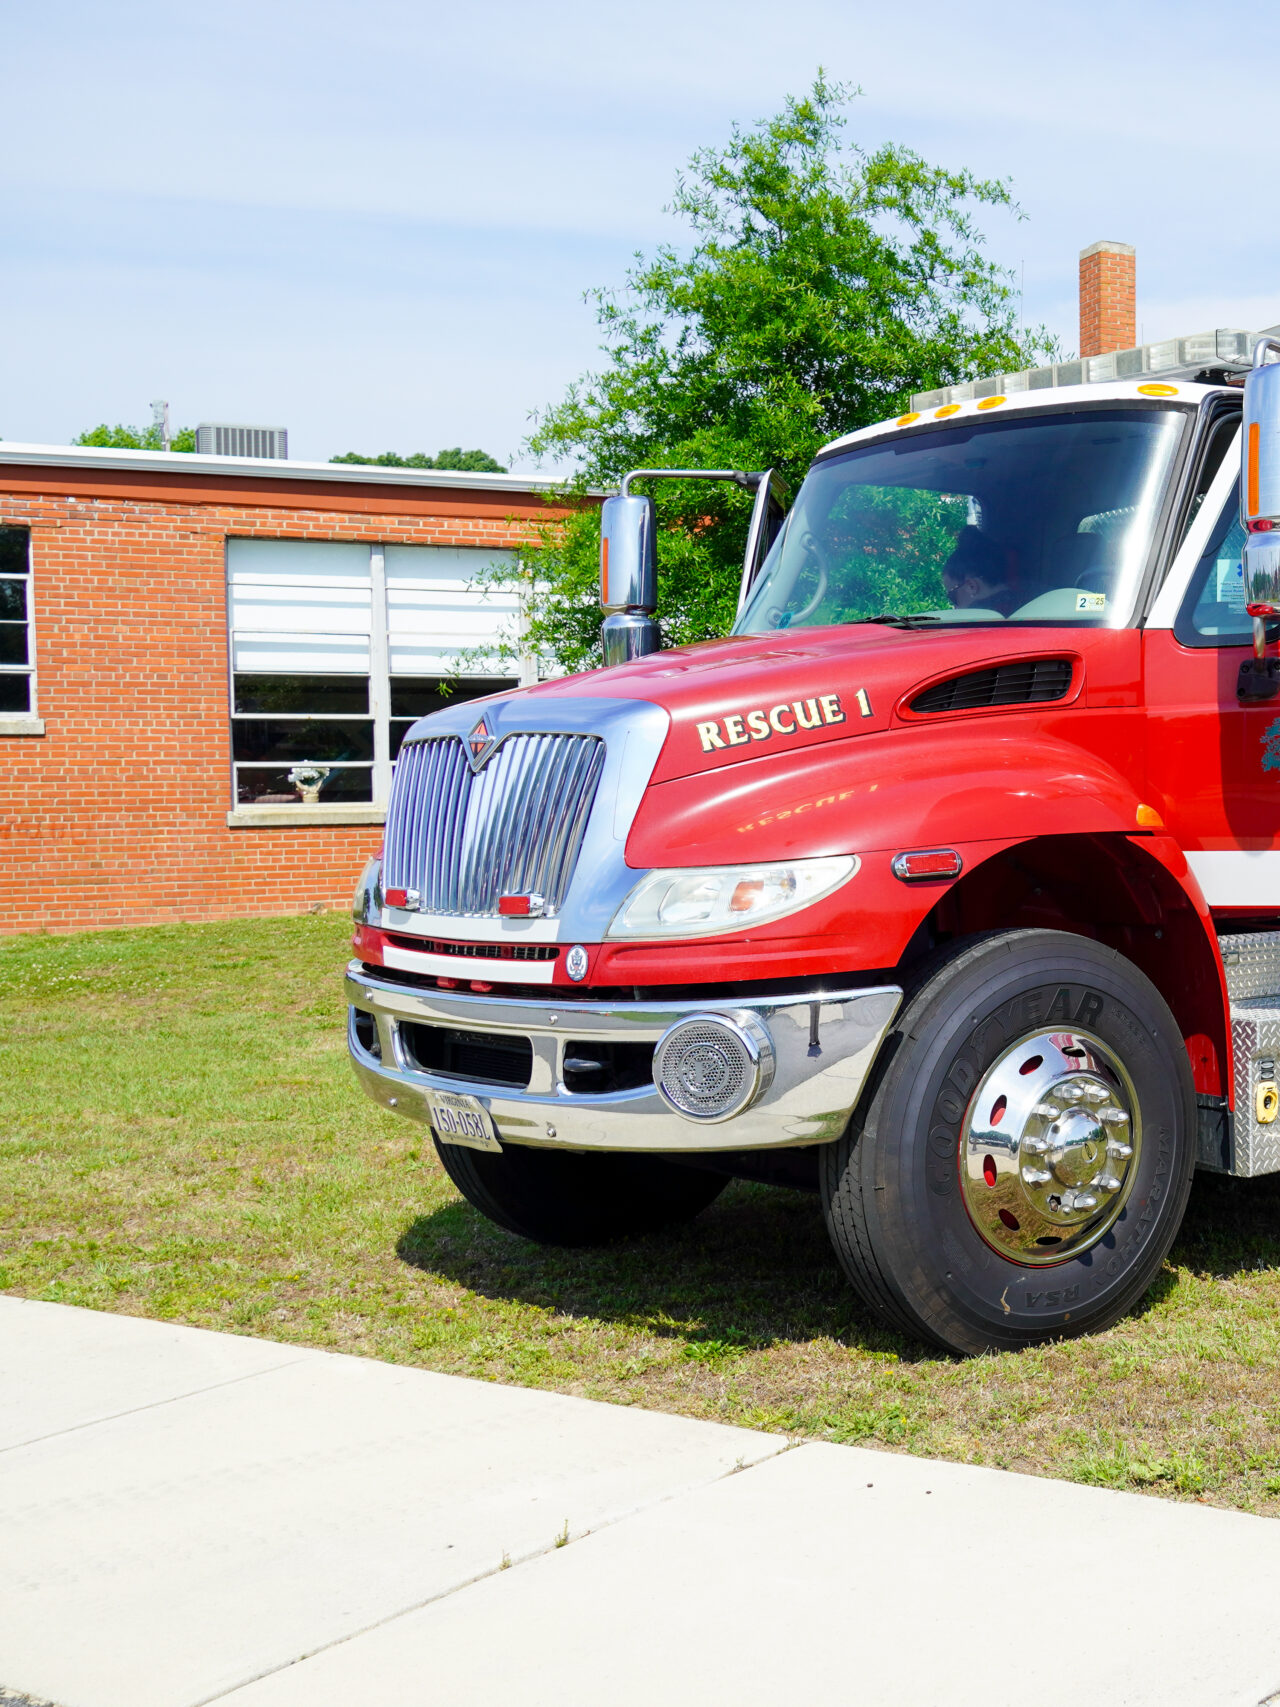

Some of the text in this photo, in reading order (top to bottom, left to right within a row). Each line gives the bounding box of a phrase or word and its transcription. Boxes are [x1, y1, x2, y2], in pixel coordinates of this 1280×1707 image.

[696, 688, 874, 753] RESCUE 1
[928, 987, 1104, 1196] GOODYEAR
[433, 1106, 491, 1140] 150-058L
[1023, 1284, 1081, 1308] RSA
